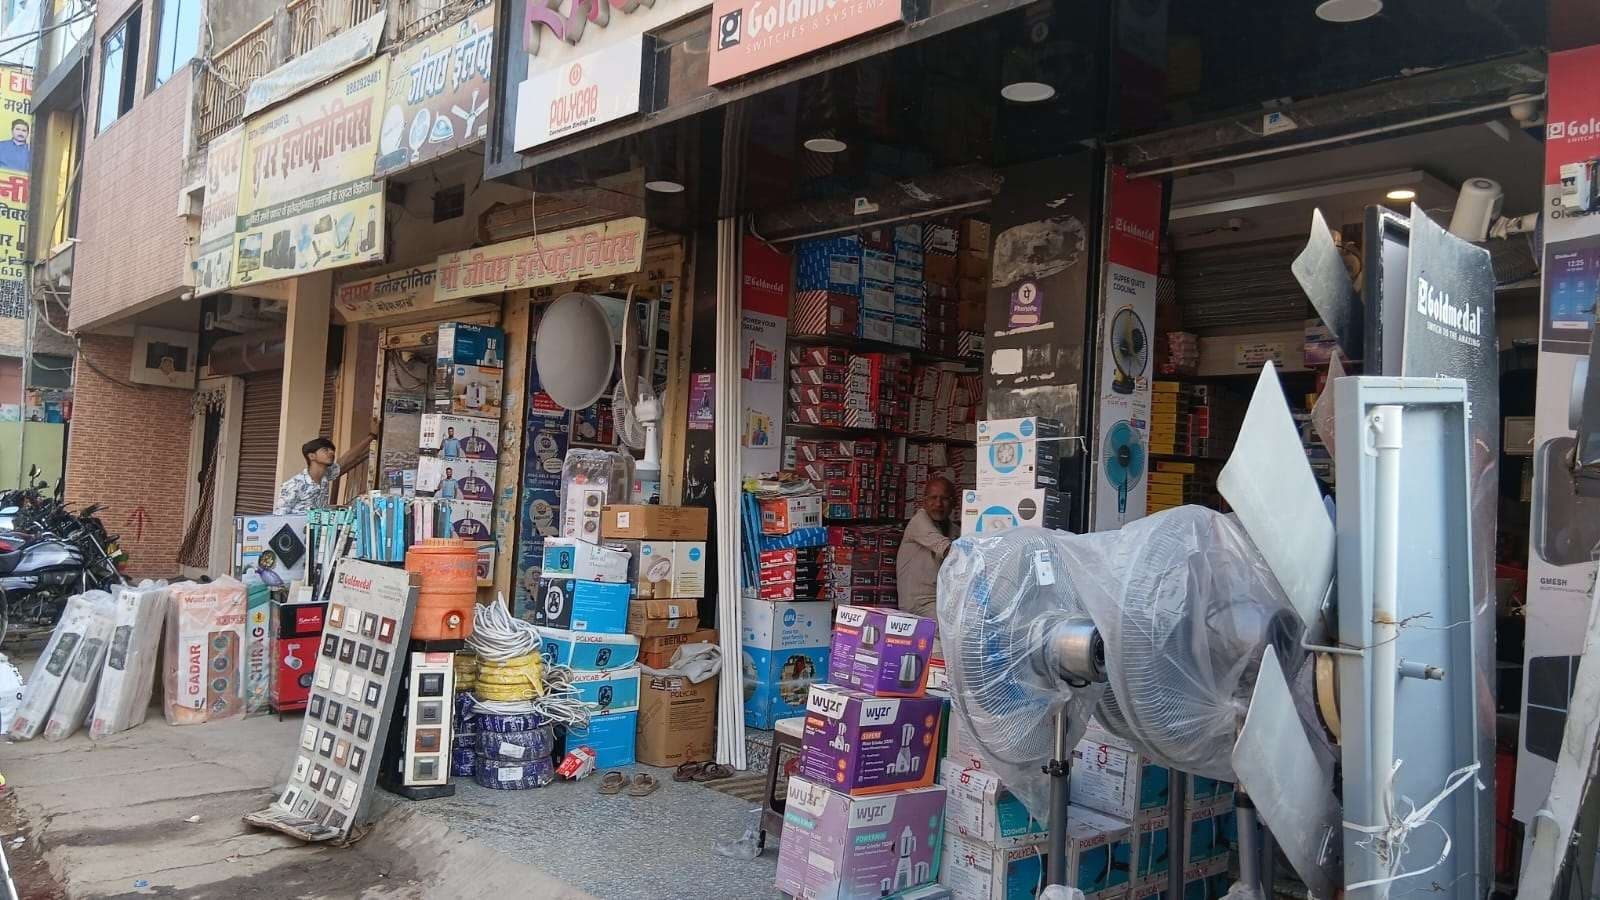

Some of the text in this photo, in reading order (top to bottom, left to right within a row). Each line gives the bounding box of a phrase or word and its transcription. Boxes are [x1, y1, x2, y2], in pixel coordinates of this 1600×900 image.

[746, 24, 805, 54] SWITCHES
[825, 1, 884, 26] SYSTEMS
[549, 84, 598, 129] POLYCAB
[1113, 273, 1129, 285] SUPER
[1113, 282, 1137, 295] COOLING
[1428, 286, 1481, 335] Goldmedal
[344, 573, 373, 590] Goldmedal
[1540, 576, 1567, 586] GMESH
[840, 610, 862, 623] wyzr
[890, 621, 912, 632] wyzr
[576, 635, 602, 643] POLYCAB
[249, 626, 265, 682] CHIRAG
[188, 644, 201, 696] GADAR
[574, 673, 600, 681] OLYCAB
[670, 690, 698, 698] POLYCAB
[812, 695, 843, 713] wyzr
[866, 706, 892, 720] wyzr
[789, 785, 819, 806] wyzr
[857, 805, 886, 821] wyzr
